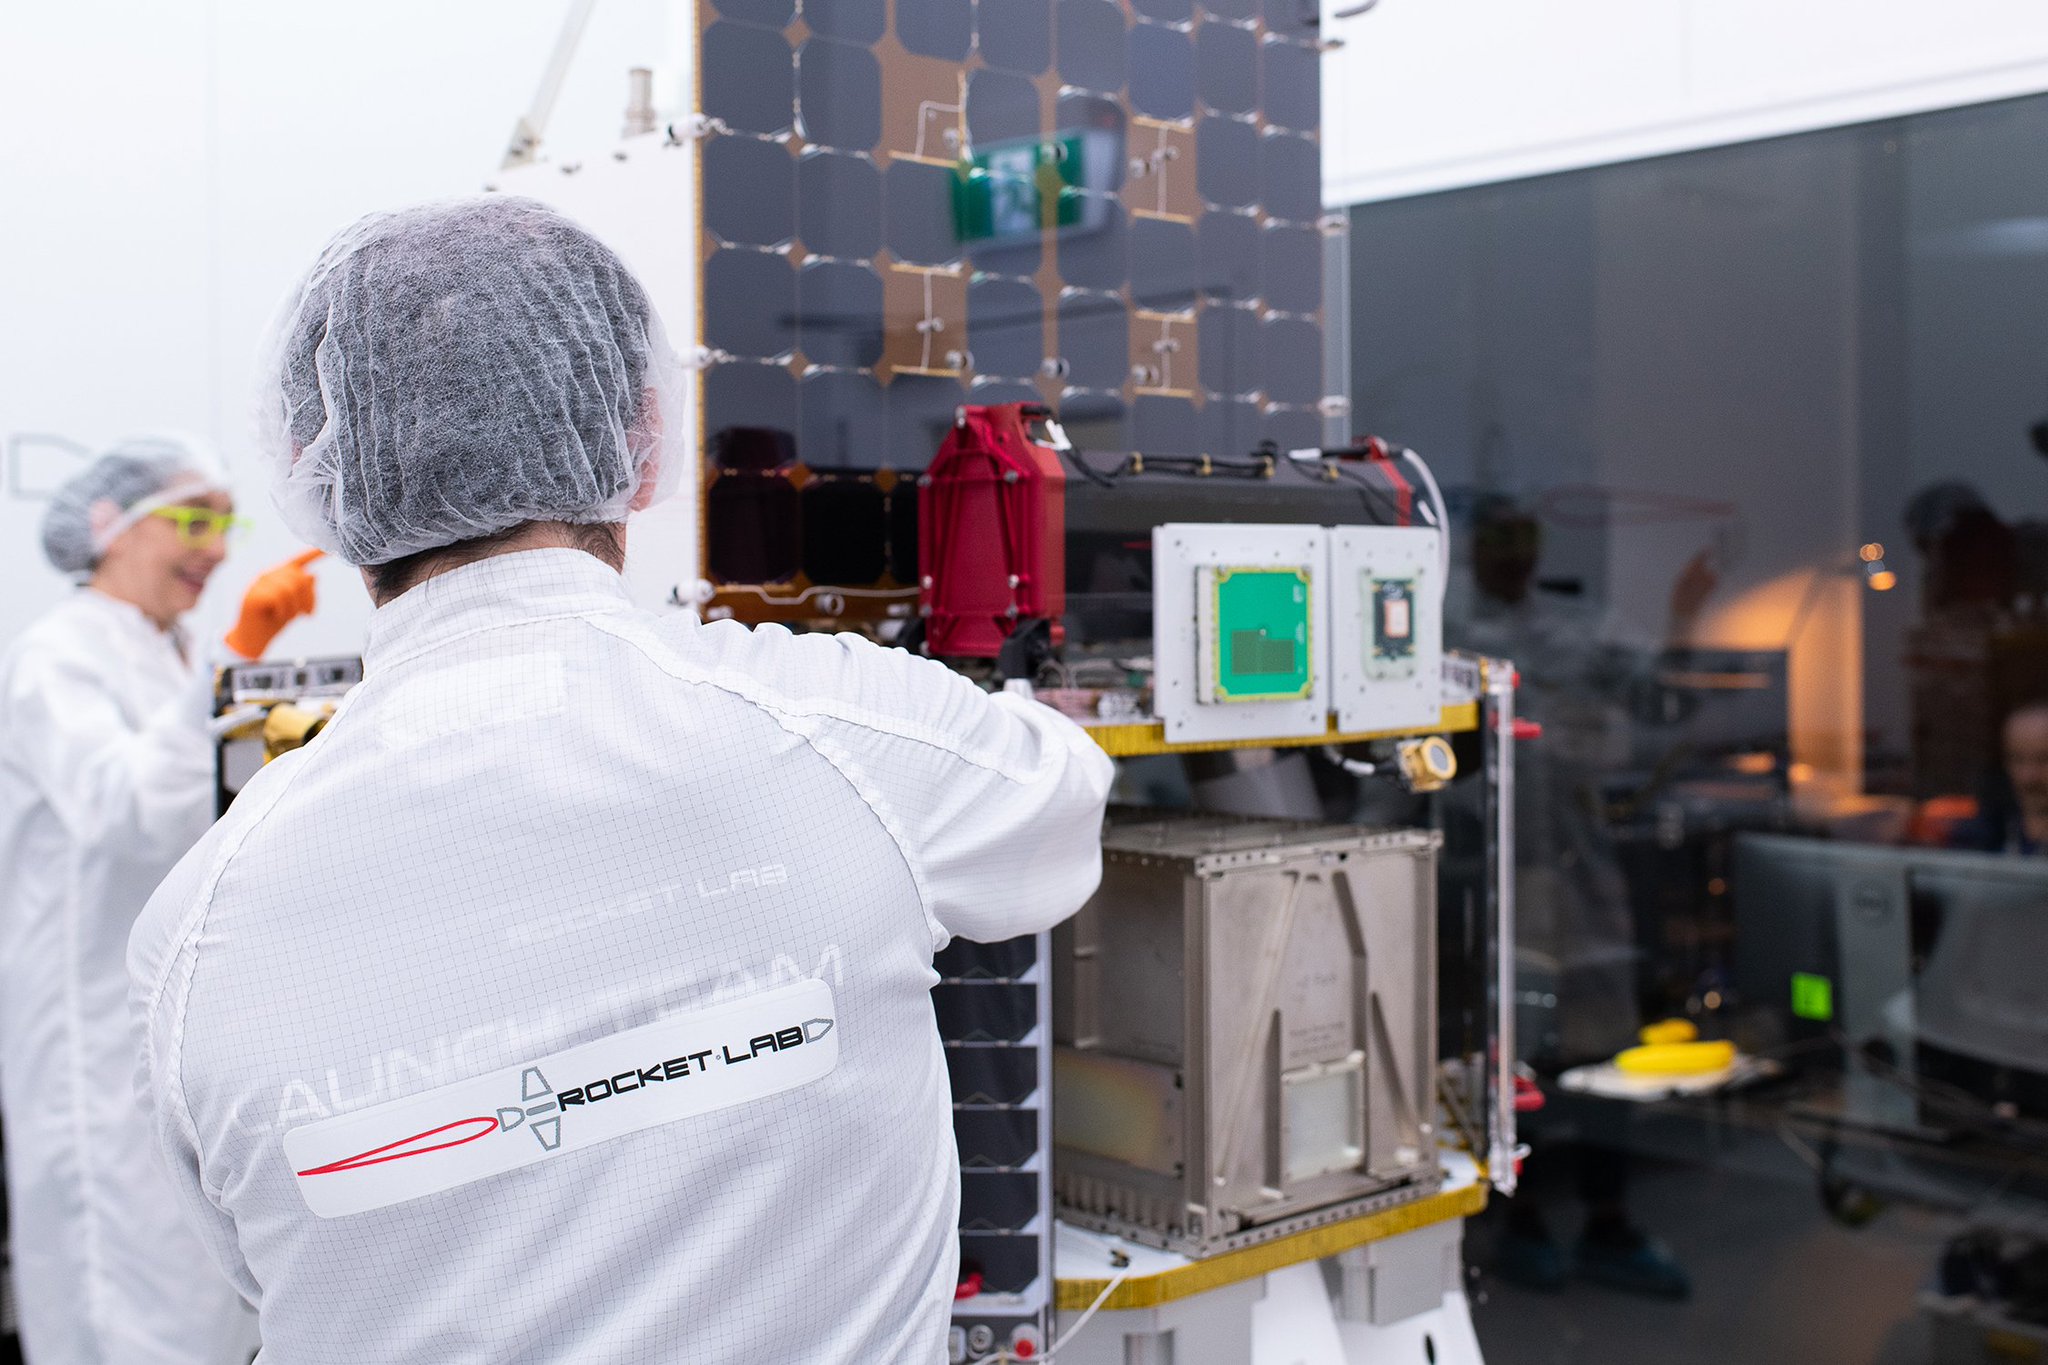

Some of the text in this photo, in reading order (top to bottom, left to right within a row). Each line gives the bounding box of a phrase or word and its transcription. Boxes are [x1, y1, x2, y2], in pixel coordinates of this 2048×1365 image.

[697, 863, 789, 900] LAB
[557, 1026, 804, 1112] ROCKET LAB
